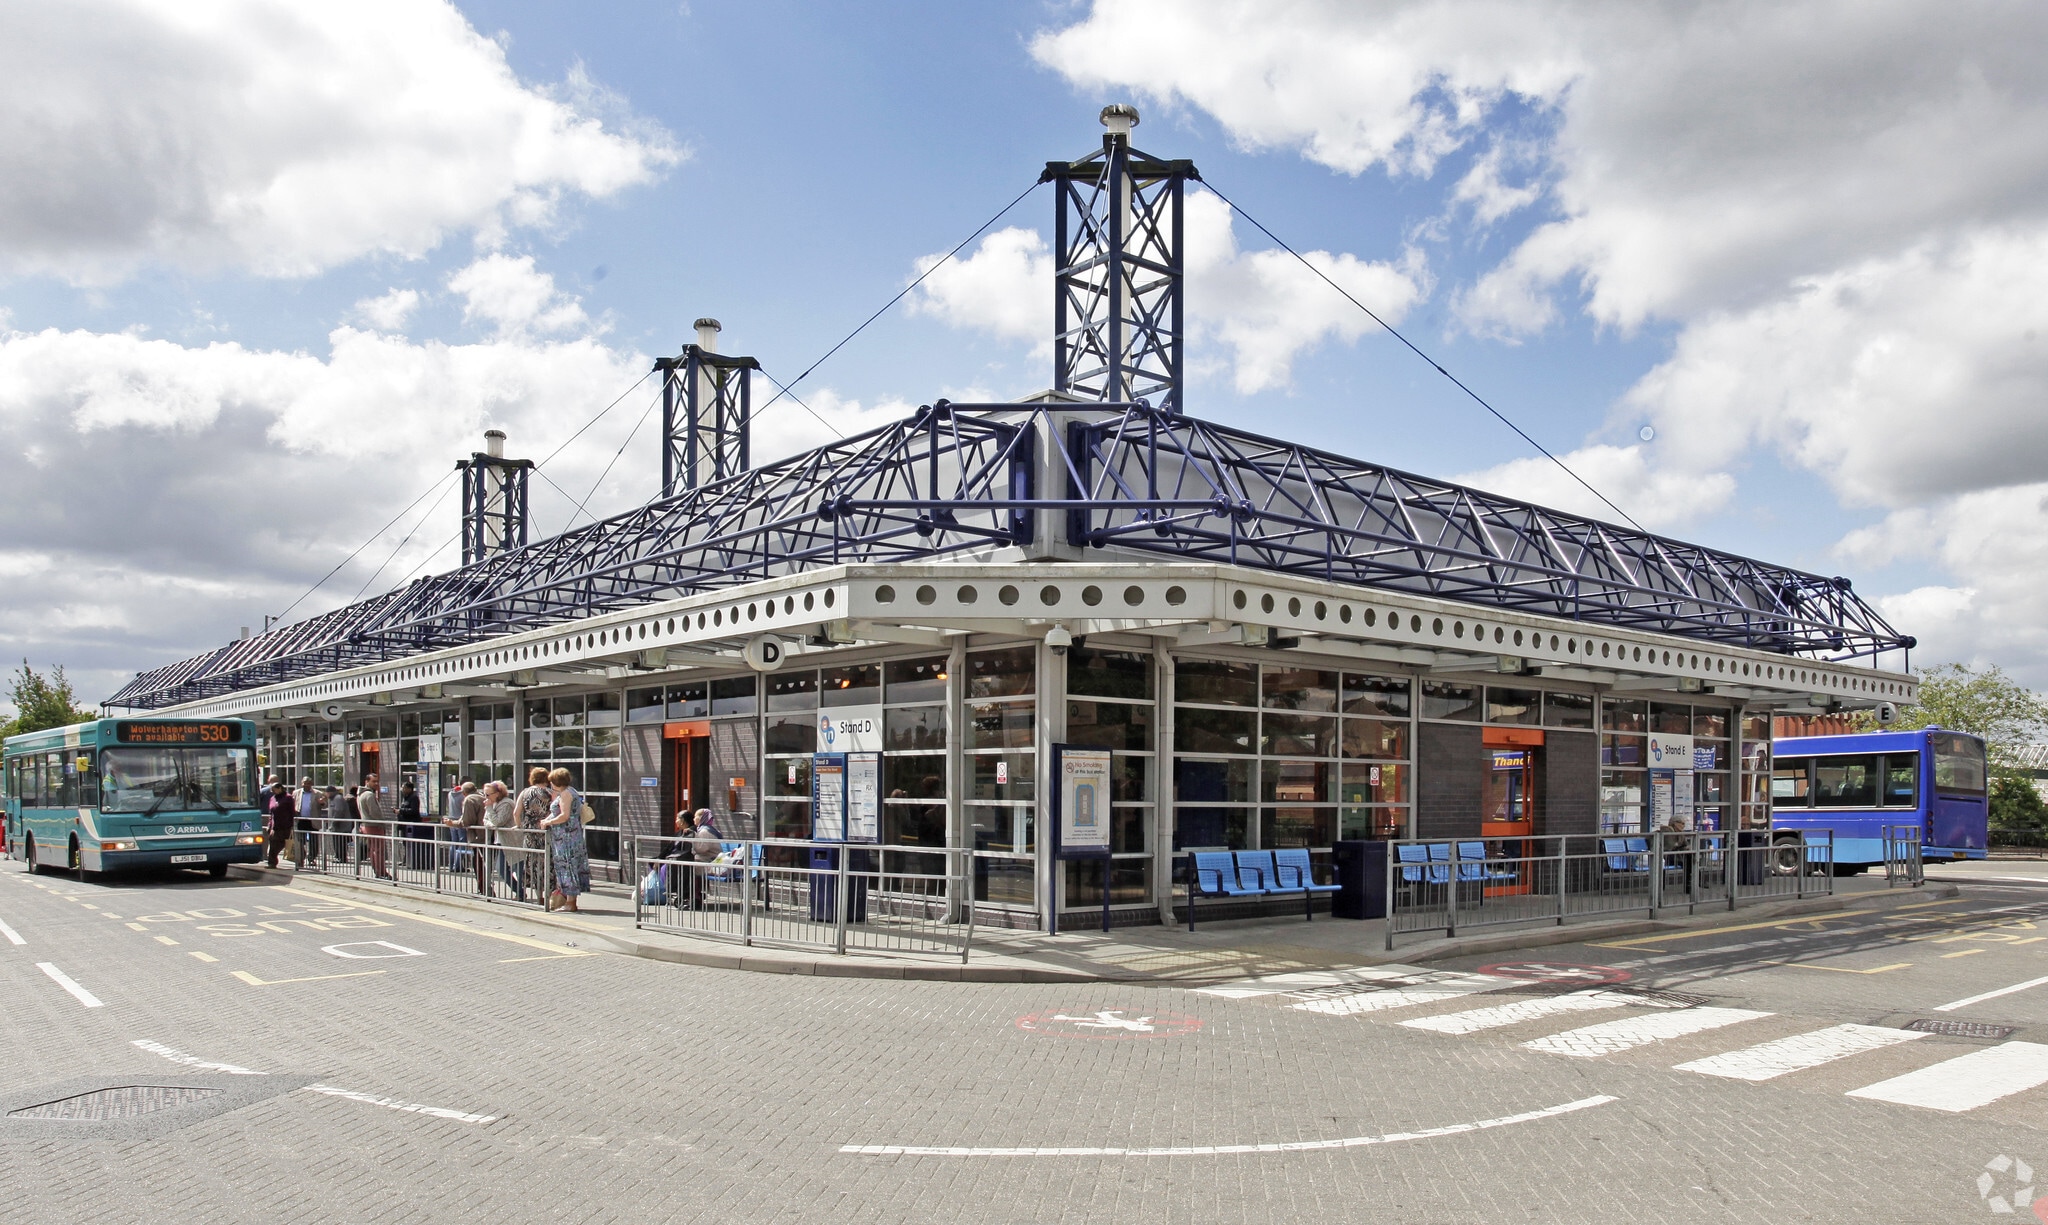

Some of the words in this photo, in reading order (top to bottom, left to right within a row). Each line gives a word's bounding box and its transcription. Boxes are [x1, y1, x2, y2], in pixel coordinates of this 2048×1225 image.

[763, 642, 779, 662] D
[327, 705, 338, 716] C
[1881, 707, 1889, 720] E
[130, 725, 198, 734] Wolverhampton
[200, 725, 230, 742] 530
[840, 720, 863, 734] Stand
[865, 720, 872, 733] D
[146, 733, 186, 742] available
[1665, 744, 1681, 755] Stand
[1682, 745, 1686, 756] E
[1083, 761, 1102, 769] Smoking
[177, 825, 210, 834] ARRIVA
[136, 903, 355, 922] STOP
[196, 915, 395, 937] BUS
[321, 940, 428, 959] D
